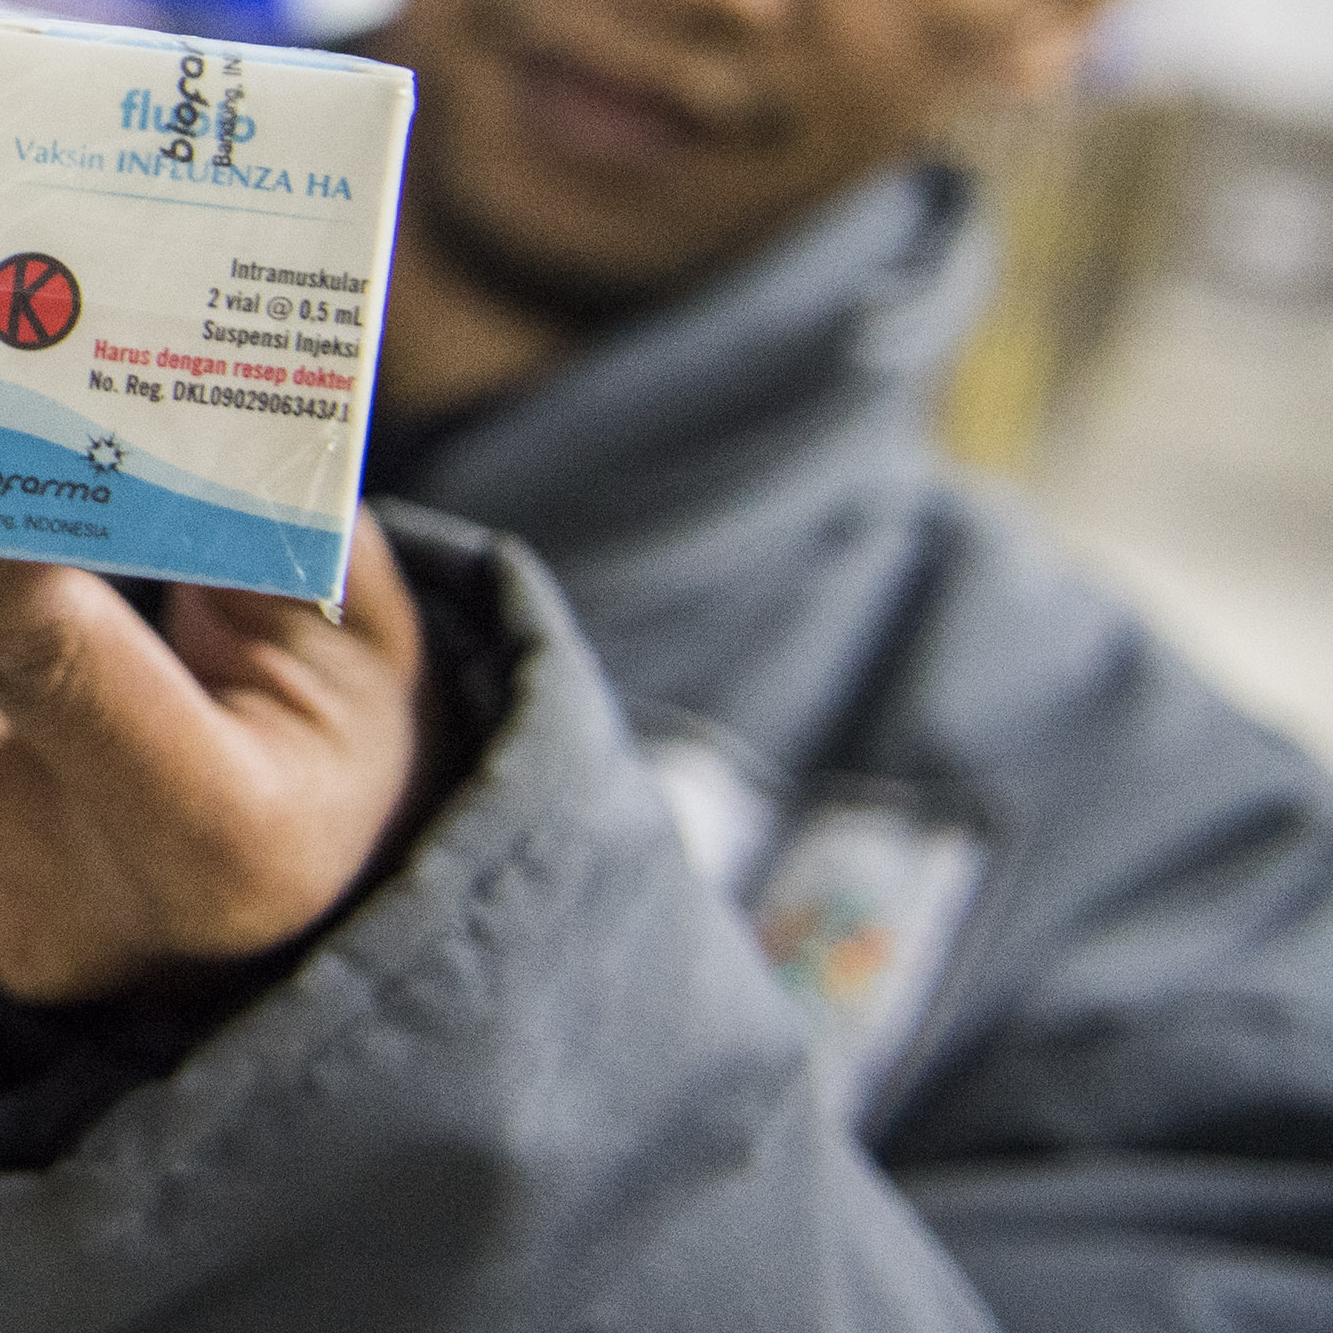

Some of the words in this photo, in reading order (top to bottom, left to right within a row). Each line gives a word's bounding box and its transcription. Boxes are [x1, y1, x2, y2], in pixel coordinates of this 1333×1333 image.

[15, 137, 104, 171] Vaksin
[116, 150, 293, 193] INFLUENZA
[306, 173, 352, 200] HA
[231, 258, 369, 294] Intramuskular
[208, 288, 220, 308] 2
[226, 293, 260, 313] vial
[335, 306, 363, 326] mL
[203, 319, 289, 350] Suspensi
[295, 331, 360, 358] Injeksi
[95, 339, 151, 366] Harus
[157, 347, 227, 377] dengan
[233, 360, 287, 386] resep
[293, 365, 356, 392] dokter
